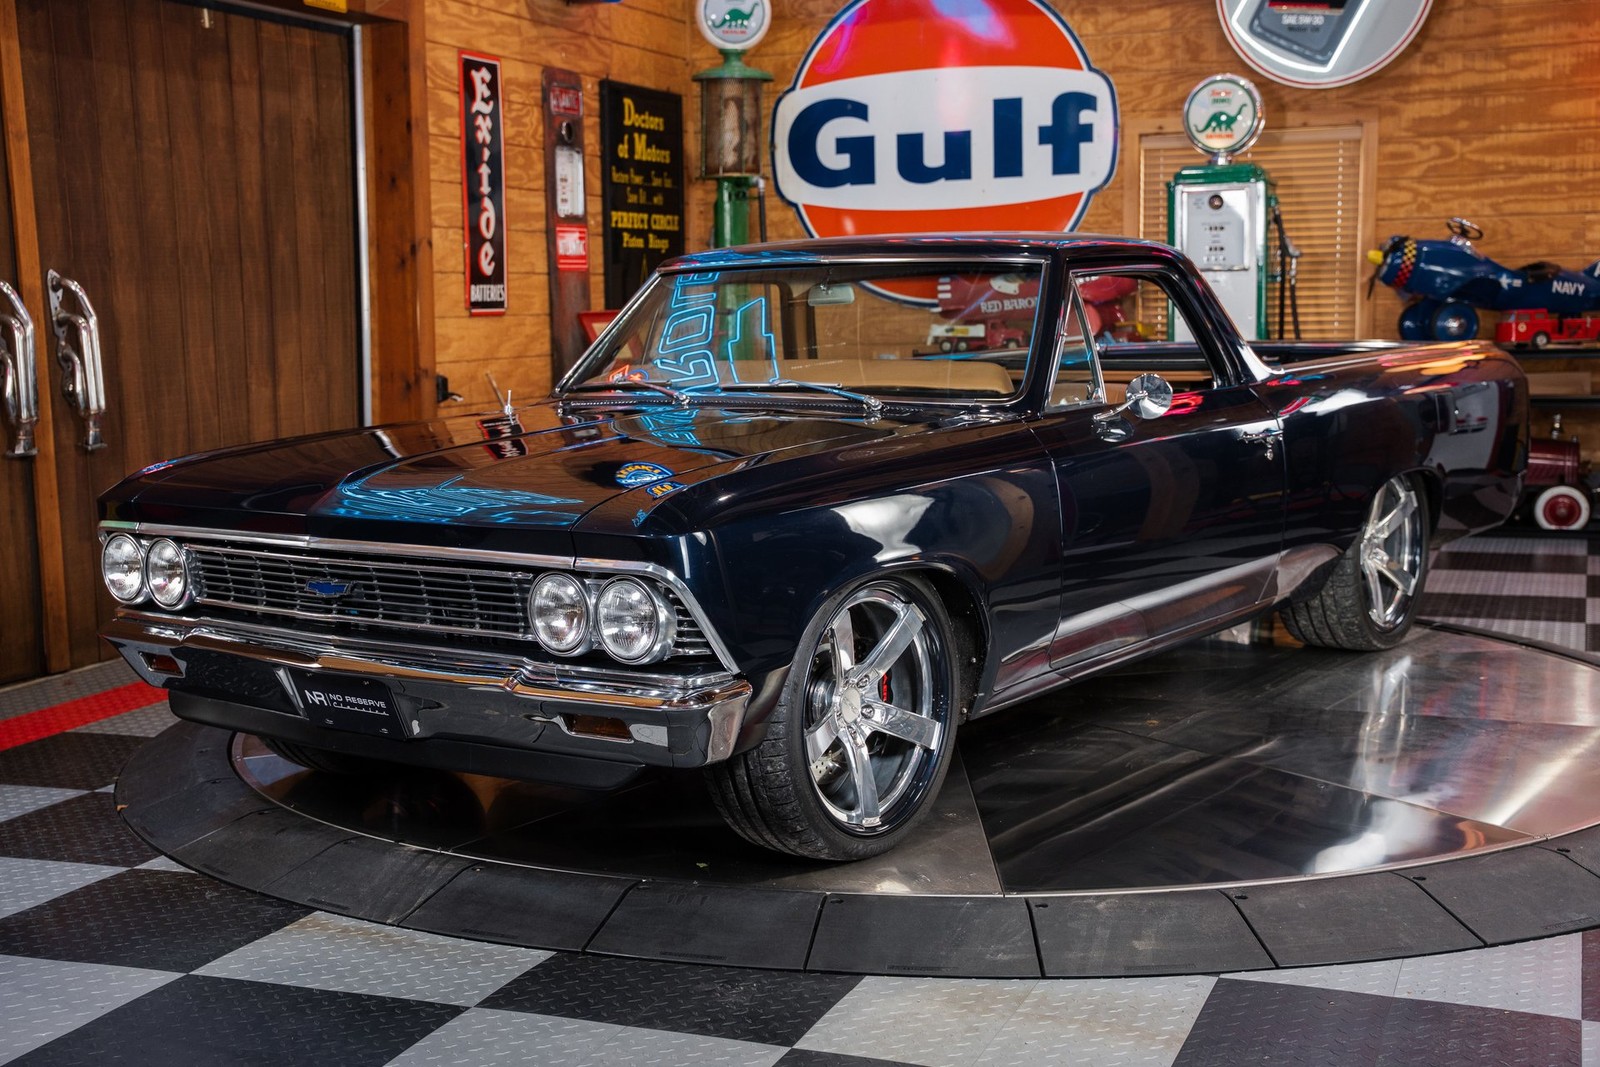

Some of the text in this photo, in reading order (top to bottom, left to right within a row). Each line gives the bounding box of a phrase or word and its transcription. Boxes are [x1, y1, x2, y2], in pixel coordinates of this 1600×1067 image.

[623, 97, 664, 131] Doctors
[634, 132, 670, 163] Motors
[788, 91, 1098, 188] Gulf
[470, 66, 496, 277] Exide
[611, 211, 679, 231] PERFECT CIRCLE
[471, 285, 504, 302] BATTERIES
[1552, 280, 1585, 296] NAVY
[981, 297, 1038, 313] RED BARO
[329, 693, 343, 701] NO
[345, 696, 387, 708] RESERVE
